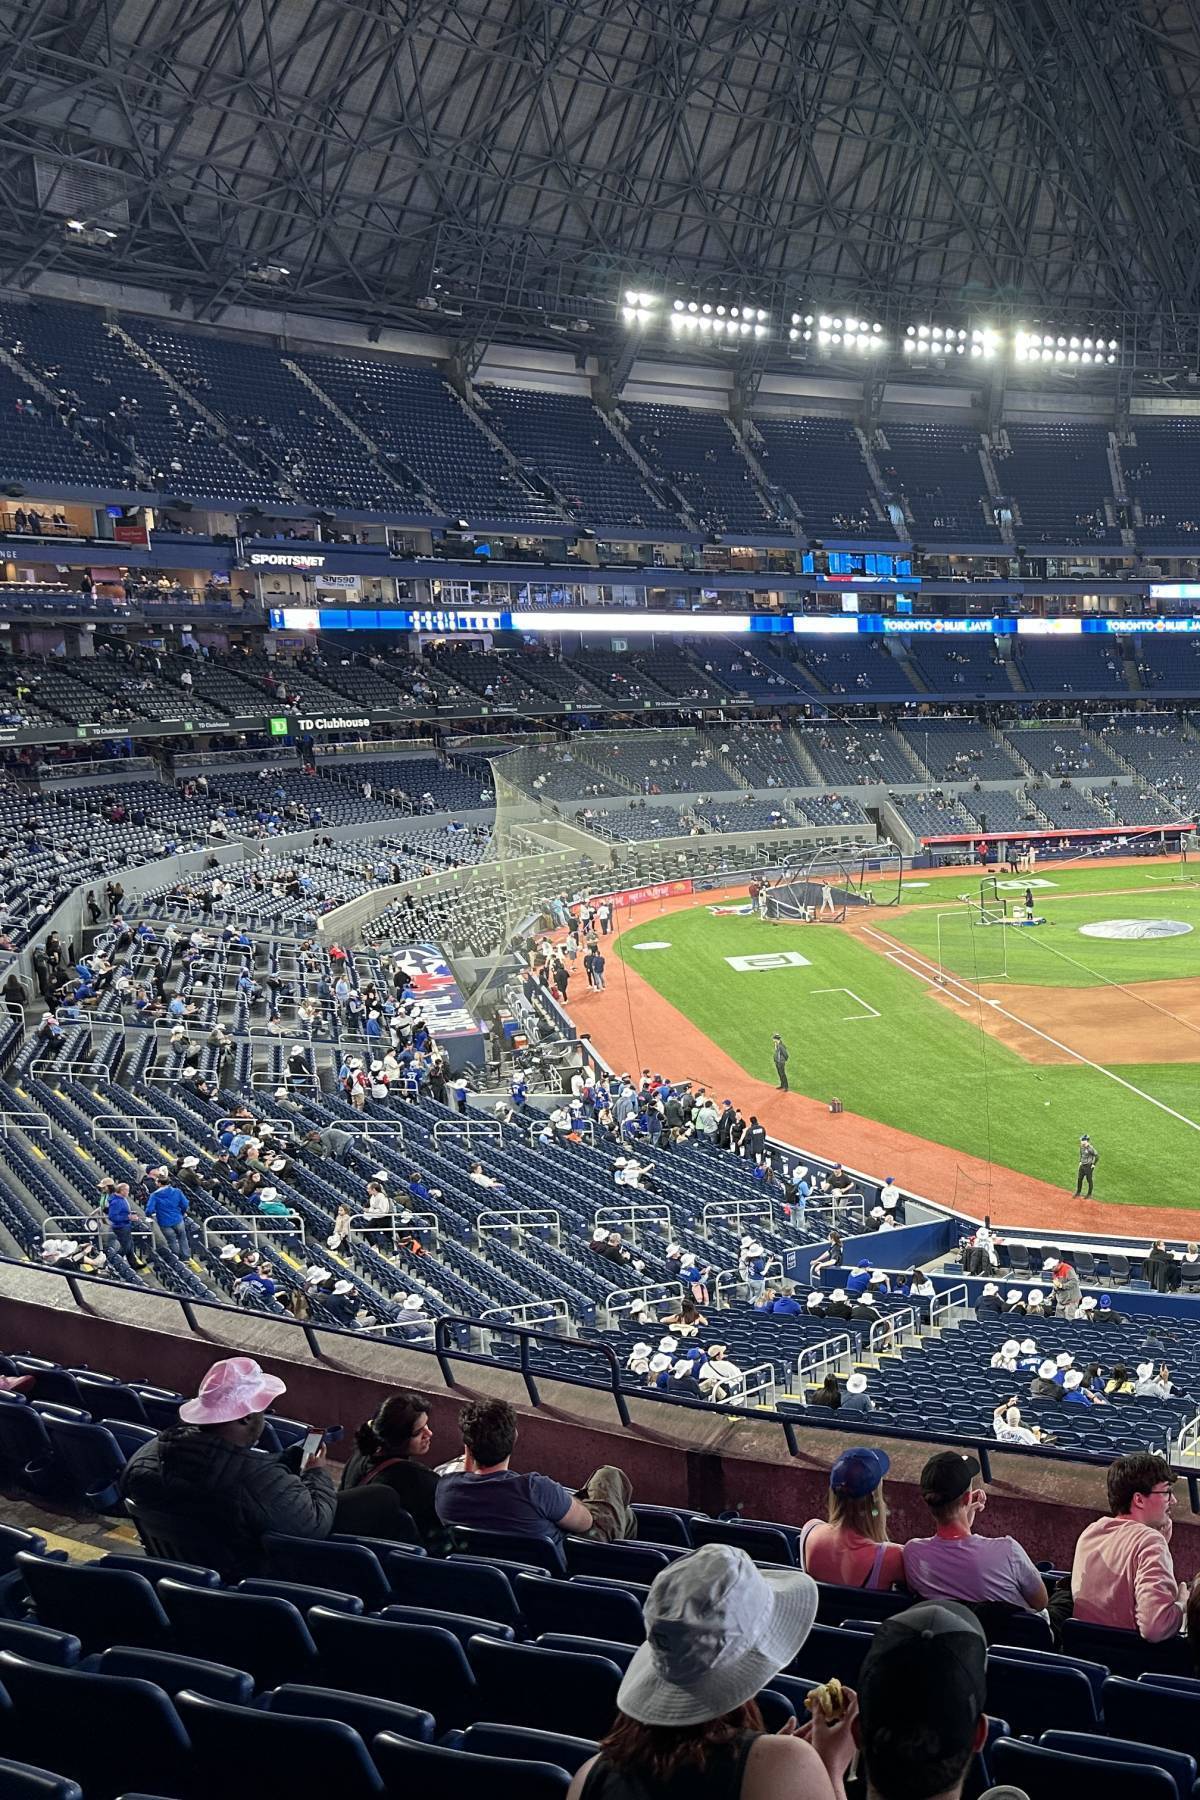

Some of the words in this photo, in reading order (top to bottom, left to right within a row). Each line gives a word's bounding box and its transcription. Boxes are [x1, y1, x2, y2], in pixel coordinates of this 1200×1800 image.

[251, 554, 325, 566] SPORTSNET
[883, 621, 932, 631] TORONTO
[944, 621, 966, 630] BLUE
[969, 621, 992, 630] JAYS
[1106, 621, 1155, 630] TORONTO
[1165, 621, 1187, 630] BLUE
[272, 721, 285, 732] TD
[298, 720, 314, 730] TD
[315, 718, 370, 729] Clubhouse
